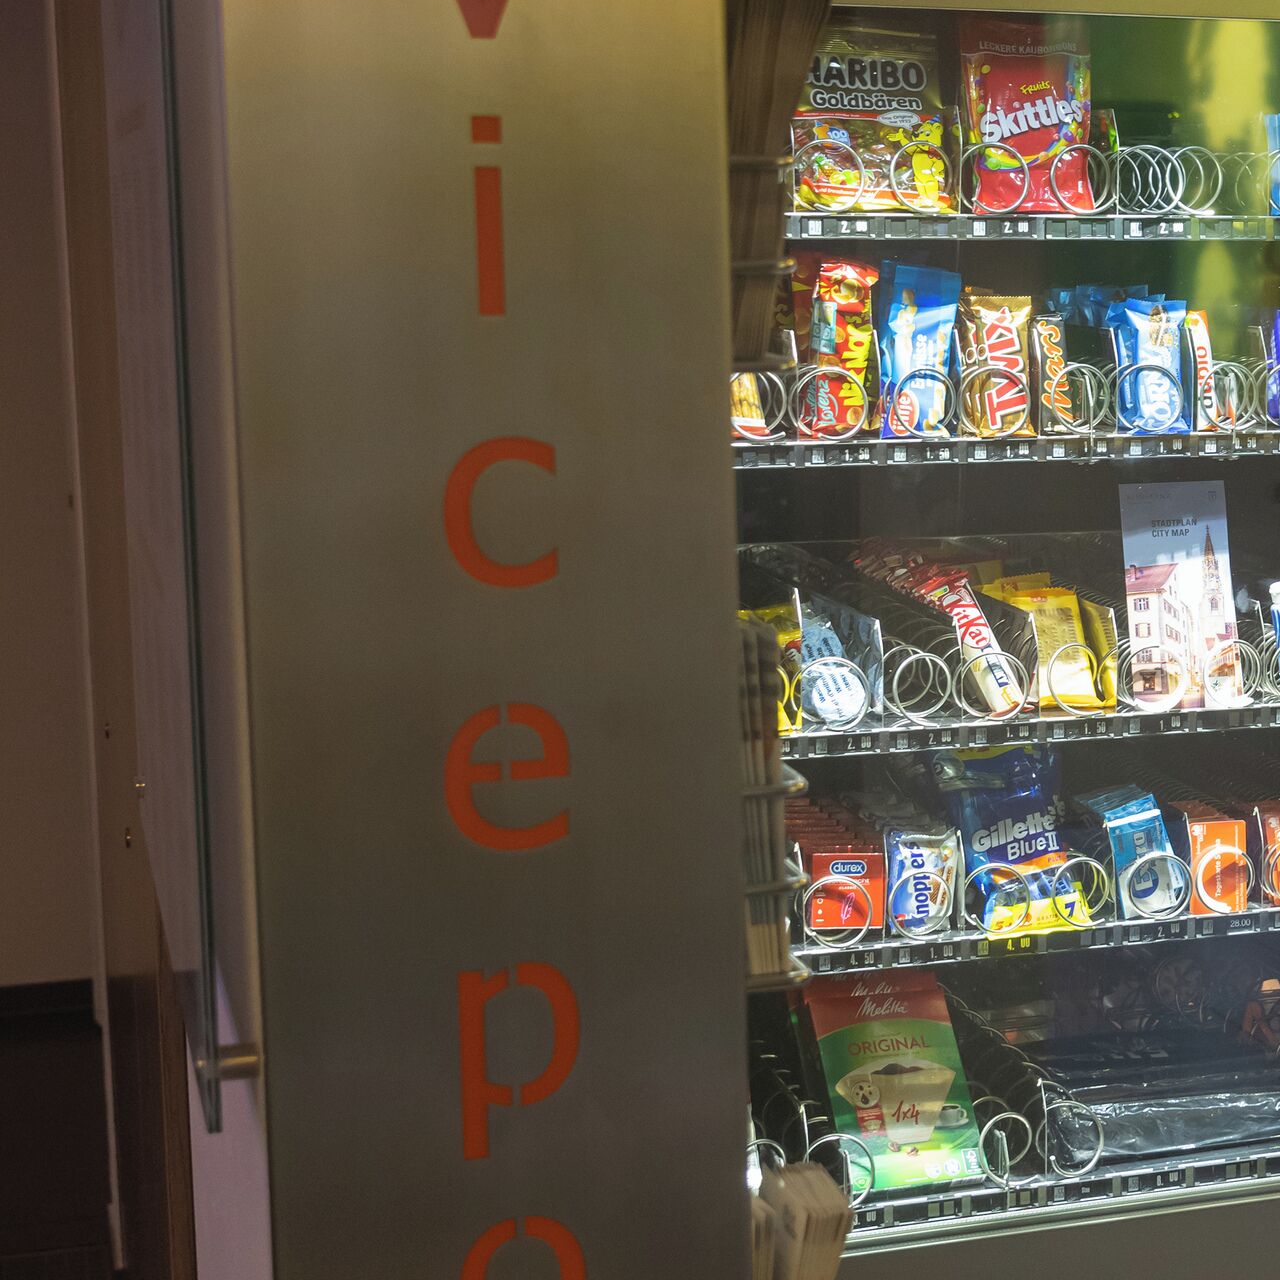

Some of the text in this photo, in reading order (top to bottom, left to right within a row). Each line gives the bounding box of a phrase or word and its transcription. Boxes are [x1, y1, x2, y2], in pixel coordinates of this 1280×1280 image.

[979, 40, 1017, 54] LECKERE
[810, 89, 923, 110] Goldbären
[980, 95, 1084, 143] Skittles
[829, 129, 847, 139] 100
[981, 307, 1029, 430] Twix
[1039, 320, 1072, 422] Mars
[1197, 345, 1214, 410] duplo
[817, 378, 839, 426] Lorenz
[1151, 518, 1198, 529] STADTPLAN
[1152, 528, 1190, 538] CITY MAP
[943, 599, 991, 647] KitKat
[972, 811, 1056, 853] Gillette
[1007, 837, 1047, 861] Blue
[833, 862, 863, 874] durex
[1064, 900, 1076, 919] 7
[1230, 918, 1251, 928] 28.00
[855, 996, 909, 1019] Melitta
[847, 1033, 931, 1056] ORIGINAL
[891, 1100, 921, 1126] 1x4
